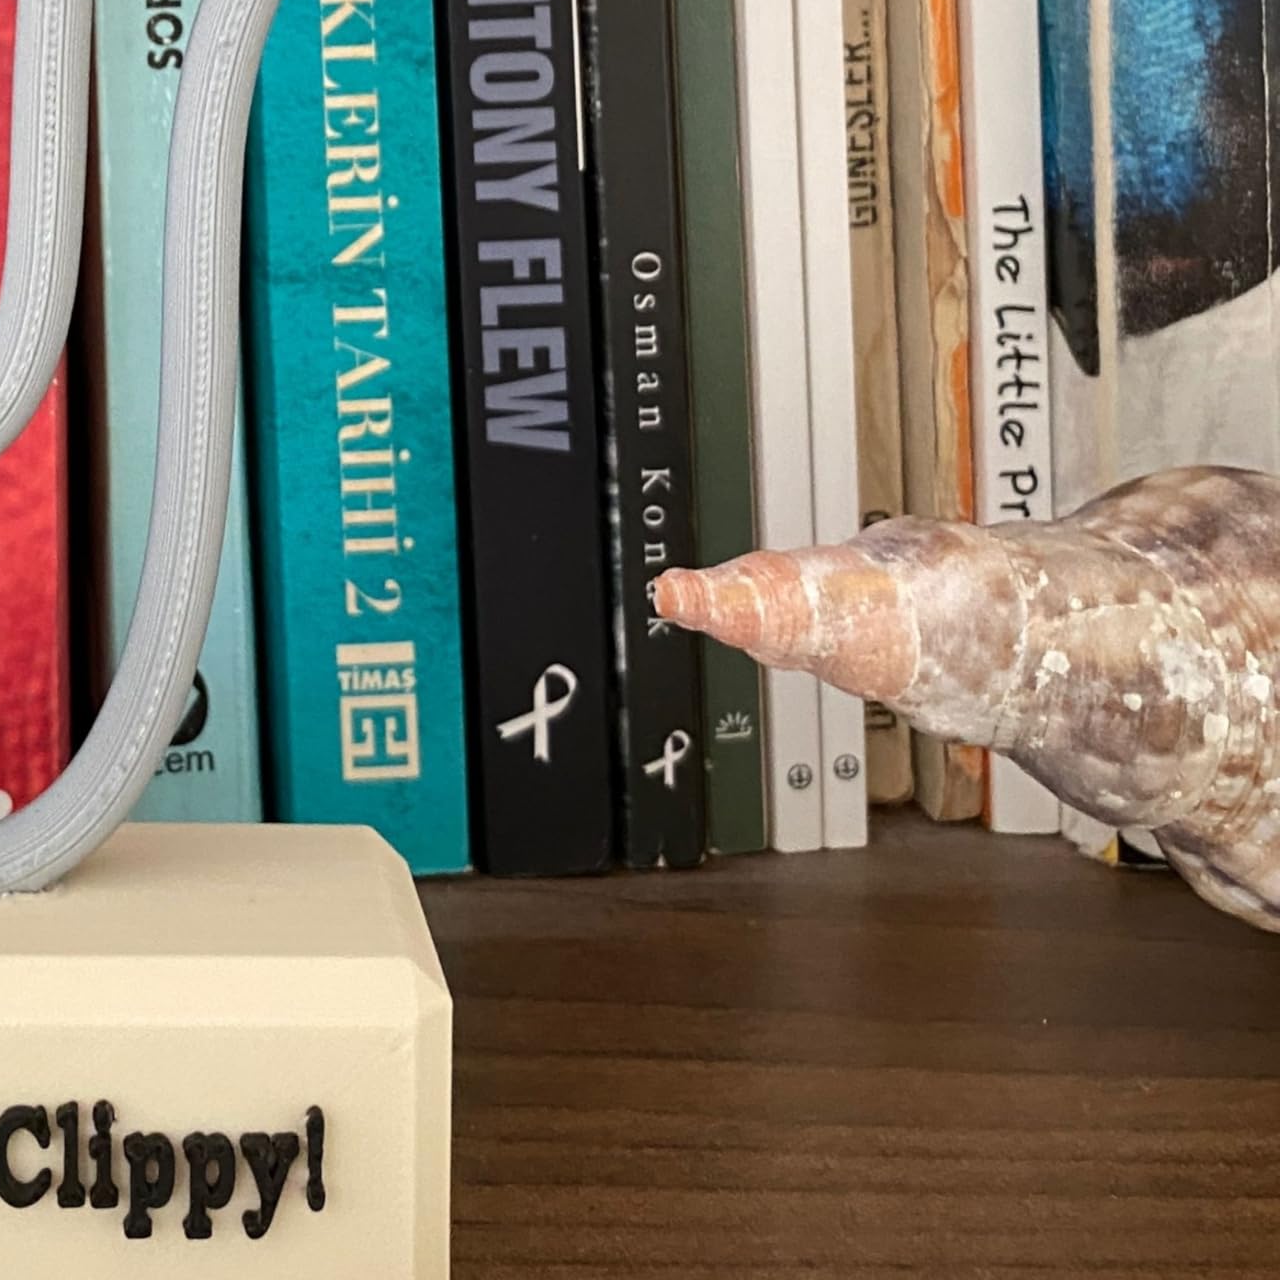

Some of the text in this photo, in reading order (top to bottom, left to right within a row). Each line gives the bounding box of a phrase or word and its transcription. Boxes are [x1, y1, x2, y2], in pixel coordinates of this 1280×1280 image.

[991, 194, 1034, 284] The
[478, 238, 572, 452] FLEW
[631, 251, 663, 429] Osman
[994, 304, 1042, 447] Little
[331, 287, 413, 556] TARİHİ
[344, 578, 402, 617] 2
[337, 667, 416, 693] TİMAŞ
